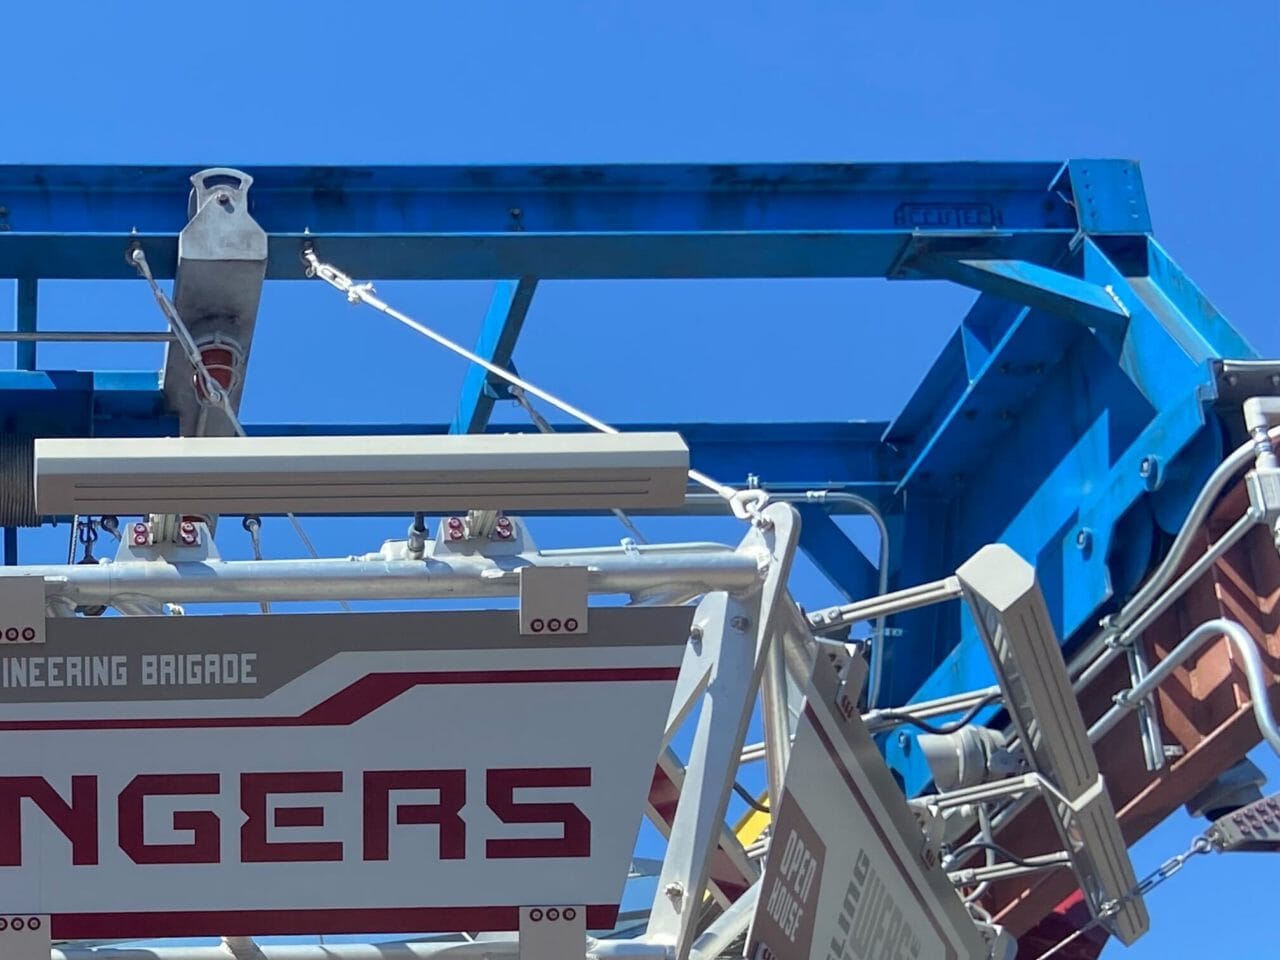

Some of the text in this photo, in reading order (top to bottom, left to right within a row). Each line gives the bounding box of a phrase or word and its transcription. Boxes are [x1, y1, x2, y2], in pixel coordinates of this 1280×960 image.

[141, 653, 258, 685] BRIGADE
[780, 829, 817, 904] OPEN
[768, 878, 804, 943] HOUSE
